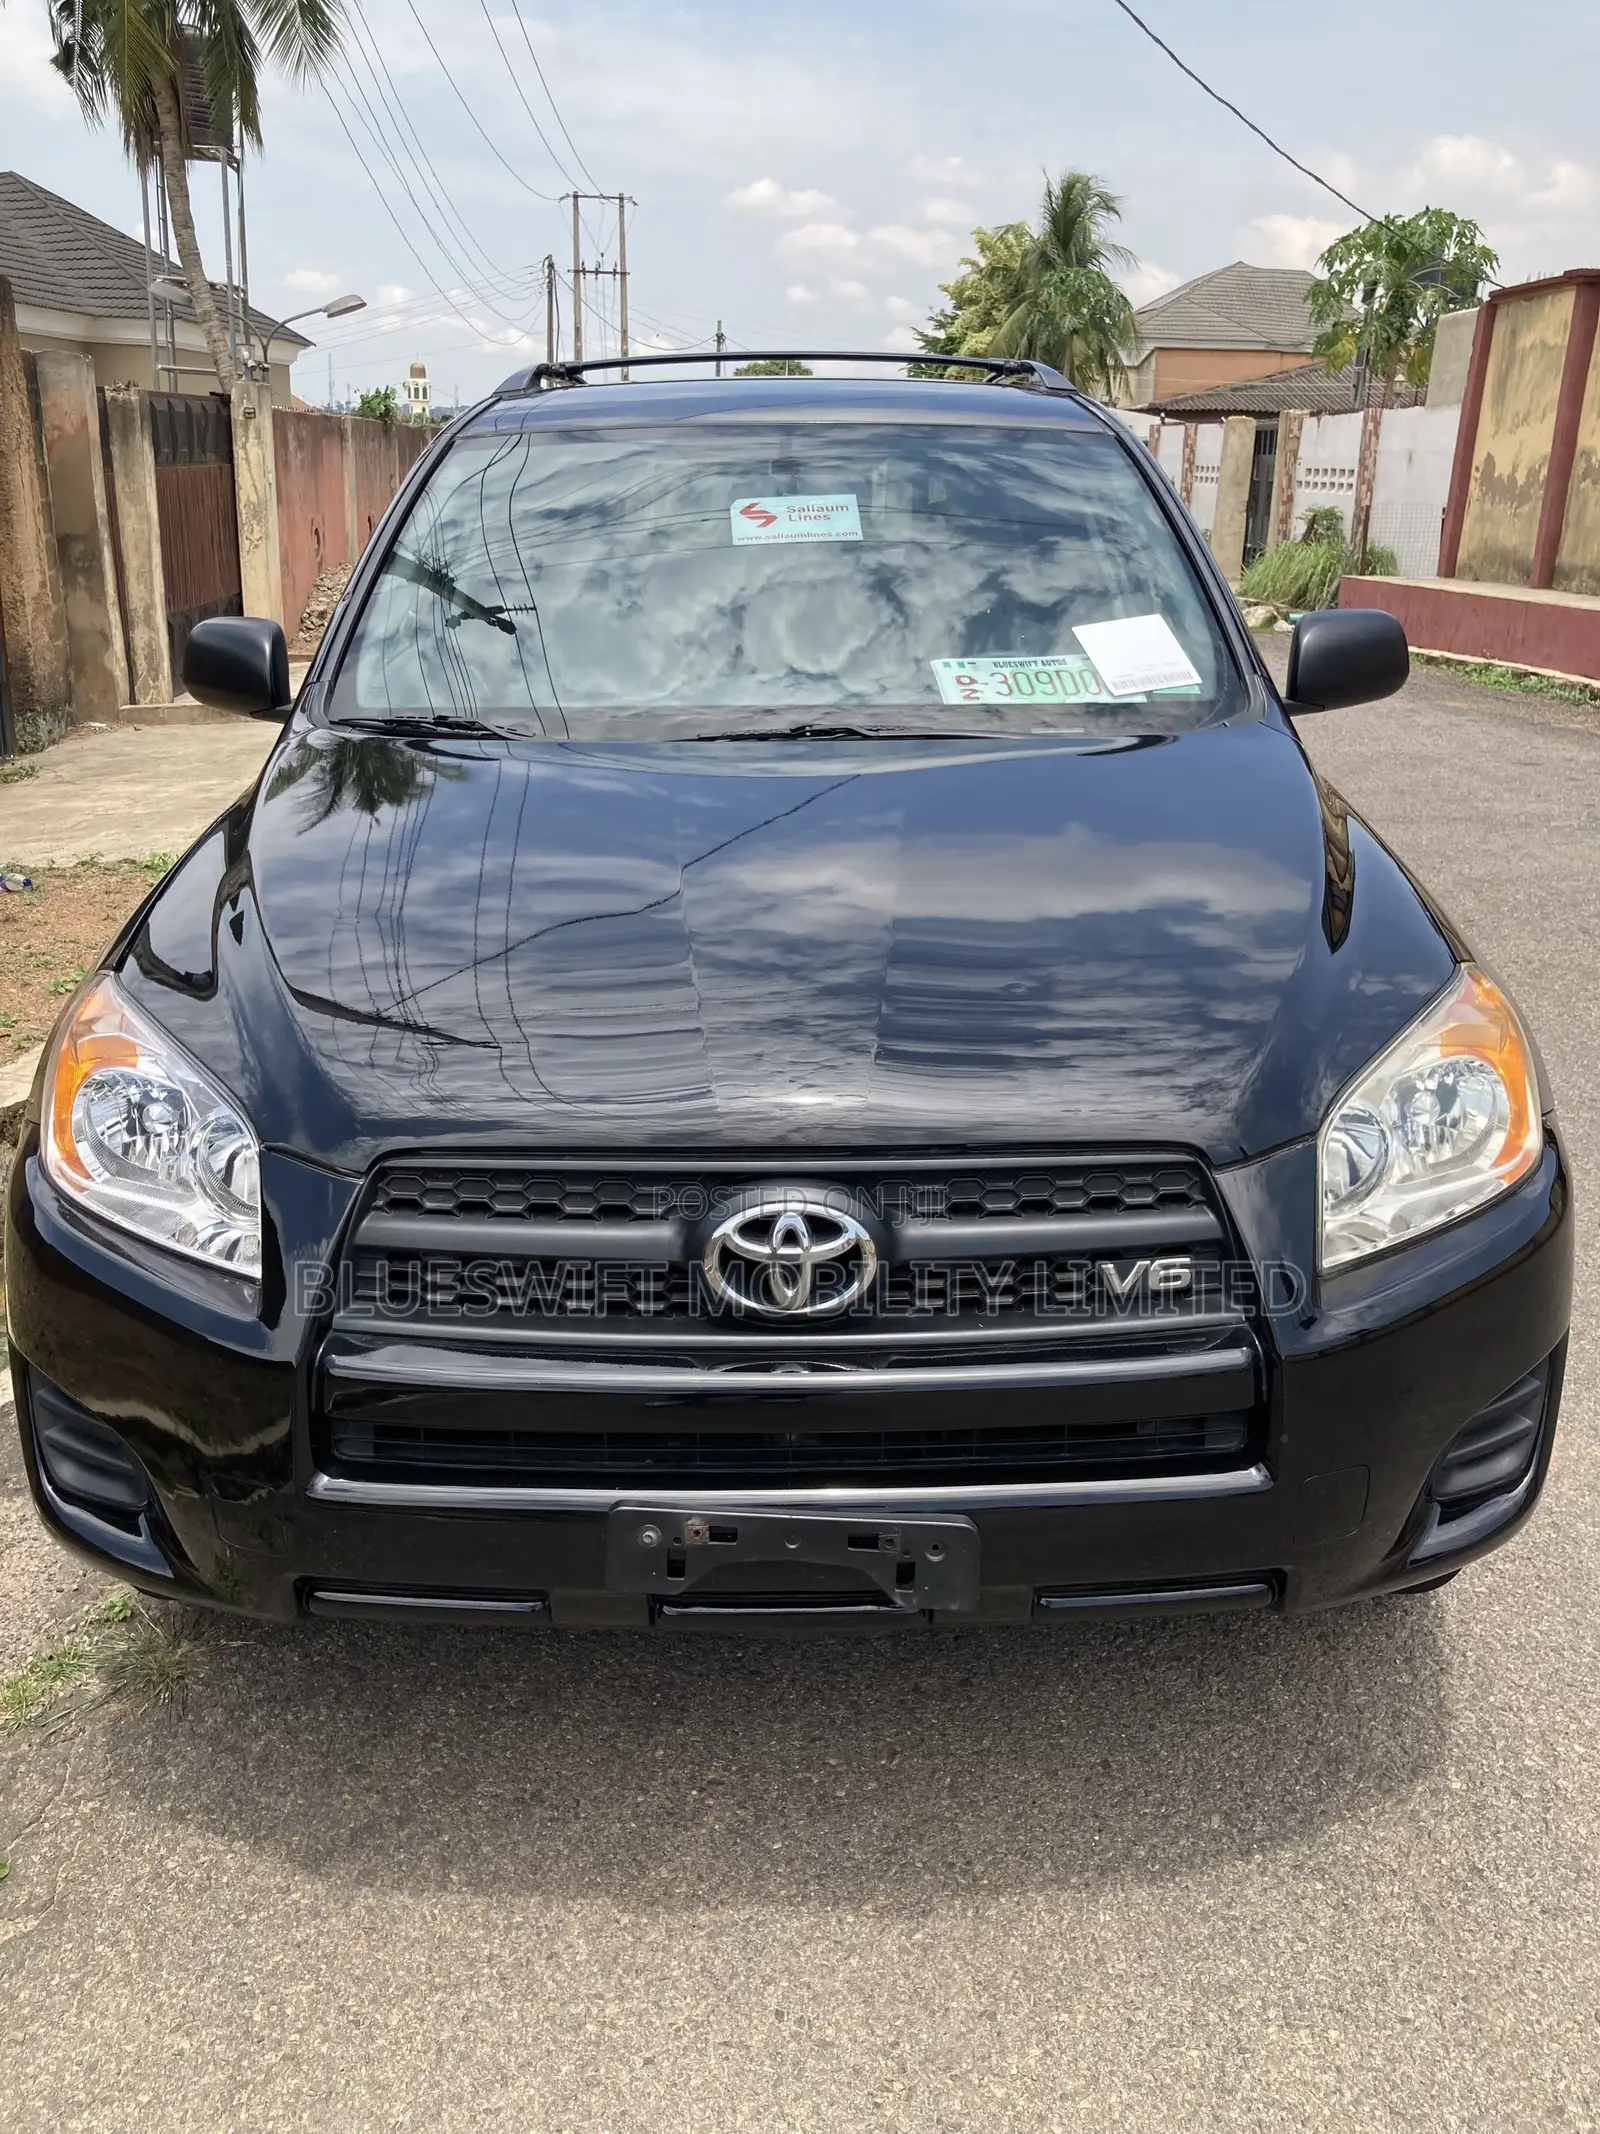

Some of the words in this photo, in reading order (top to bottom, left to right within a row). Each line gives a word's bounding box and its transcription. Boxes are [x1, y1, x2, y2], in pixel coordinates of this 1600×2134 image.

[788, 514, 831, 522] Lines
[992, 660, 1039, 669] BLUESWIFT
[1100, 1257, 1192, 1294] V6
